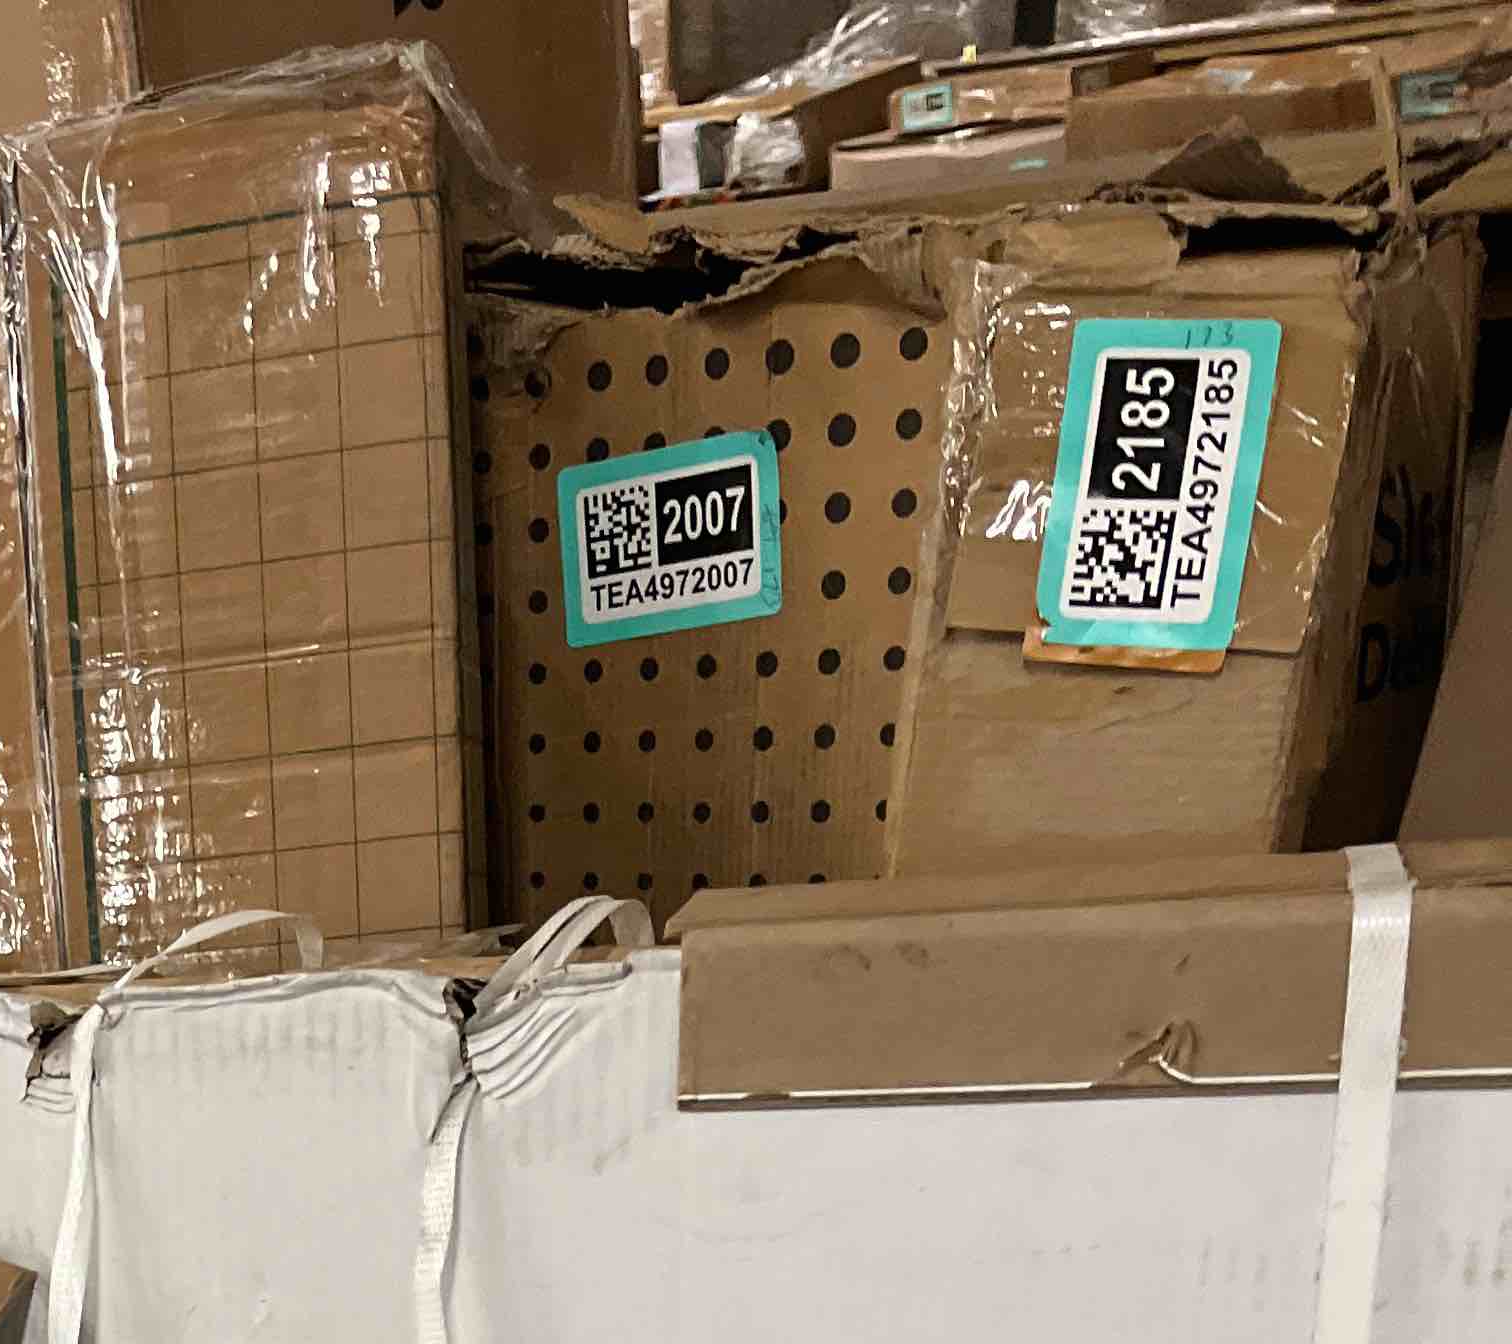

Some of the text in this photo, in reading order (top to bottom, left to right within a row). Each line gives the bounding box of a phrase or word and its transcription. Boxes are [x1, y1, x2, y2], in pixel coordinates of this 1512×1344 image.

[1110, 366, 1176, 493] 2185
[662, 485, 746, 545] 2007
[1169, 357, 1239, 608] TEA4972185
[590, 557, 755, 612] TEA4972007
